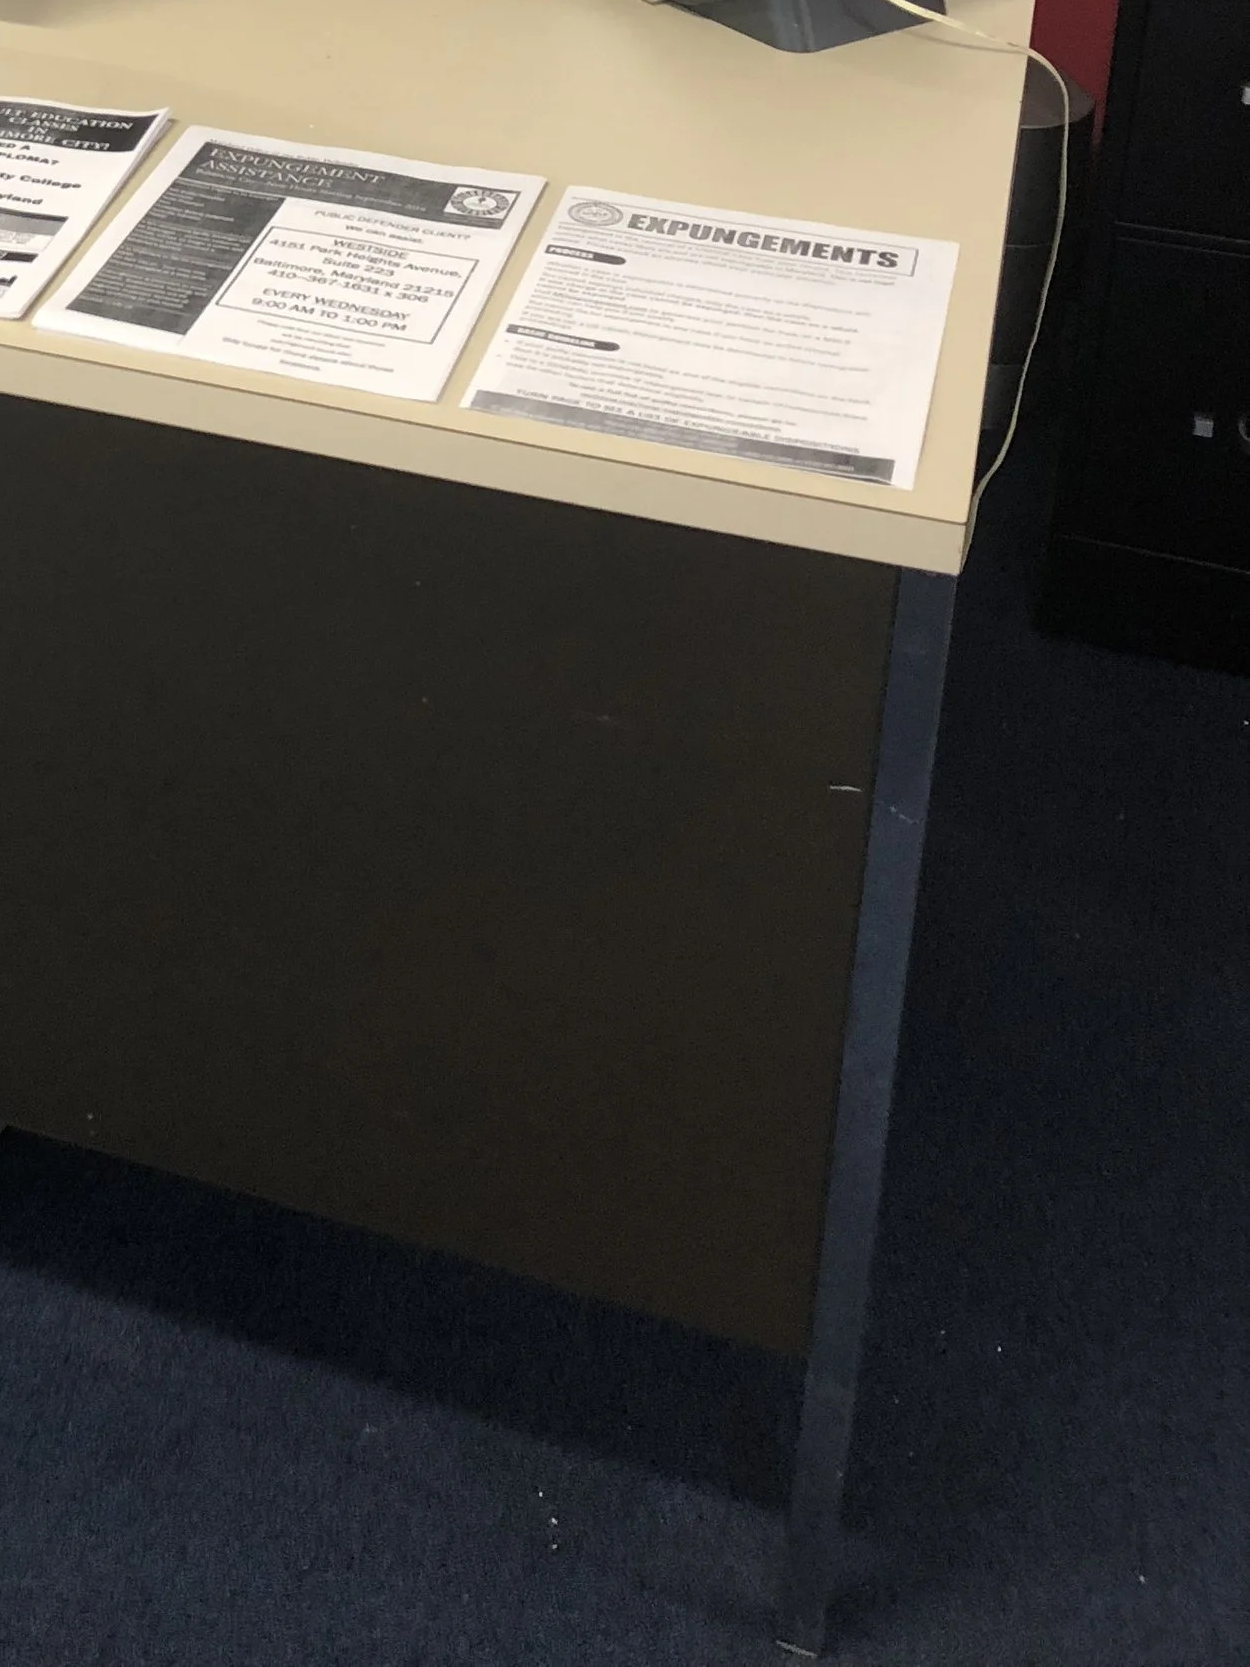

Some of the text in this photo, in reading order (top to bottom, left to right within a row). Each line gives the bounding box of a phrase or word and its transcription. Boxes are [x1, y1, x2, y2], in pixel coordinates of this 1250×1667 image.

[8, 116, 80, 133] CLASSES
[27, 125, 49, 134] IN
[29, 109, 134, 130] EDUCATION
[13, 143, 31, 151] A
[201, 160, 334, 188] ASSISTANCE
[209, 147, 387, 184] EXPUNGEMENT
[20, 174, 82, 189] College
[314, 210, 471, 240] PUBLIC DEFENDER CLIENT?
[333, 239, 410, 260] WESTSIDE
[627, 213, 900, 270] EXPUNGEMENTS
[270, 239, 462, 279] 4151 Park Heights Avenue,
[322, 257, 395, 278] Suite 223
[253, 257, 454, 298] Baltimore, Maryland 21215
[262, 288, 411, 321] EVERY WEDNESDAY
[396, 291, 429, 303] 306
[251, 297, 407, 332] 9:00 AM TO 1:00 PM
